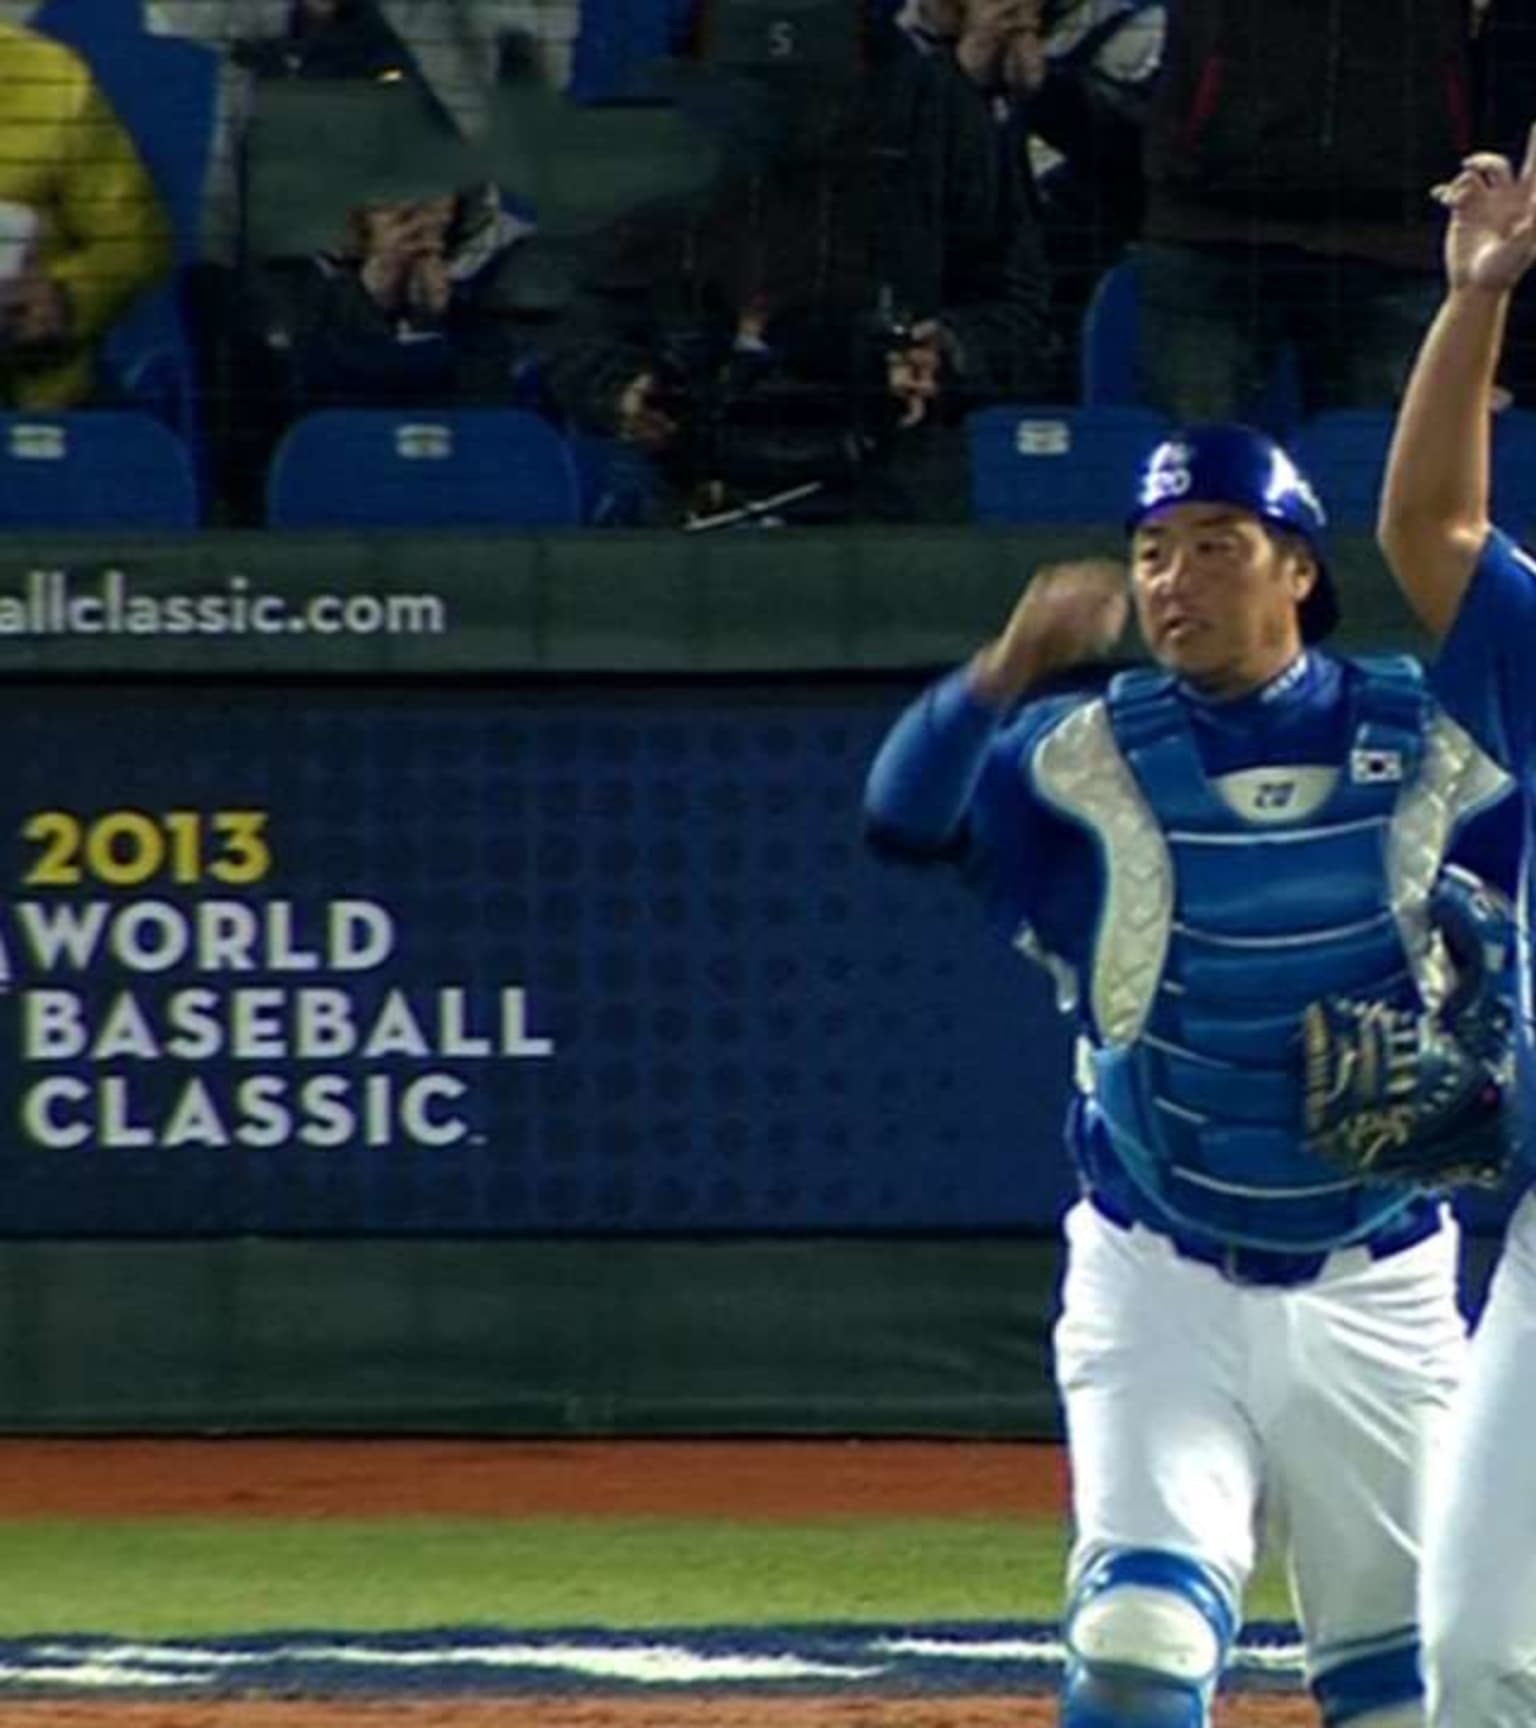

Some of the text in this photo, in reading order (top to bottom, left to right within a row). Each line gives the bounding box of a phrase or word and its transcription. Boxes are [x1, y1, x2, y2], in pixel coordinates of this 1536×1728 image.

[0, 571, 444, 634] allclassic.com
[23, 812, 271, 885] 2013
[17, 900, 393, 971] WORLD
[25, 987, 553, 1059] BASEBALL
[23, 1074, 469, 1147] CLASSIC
